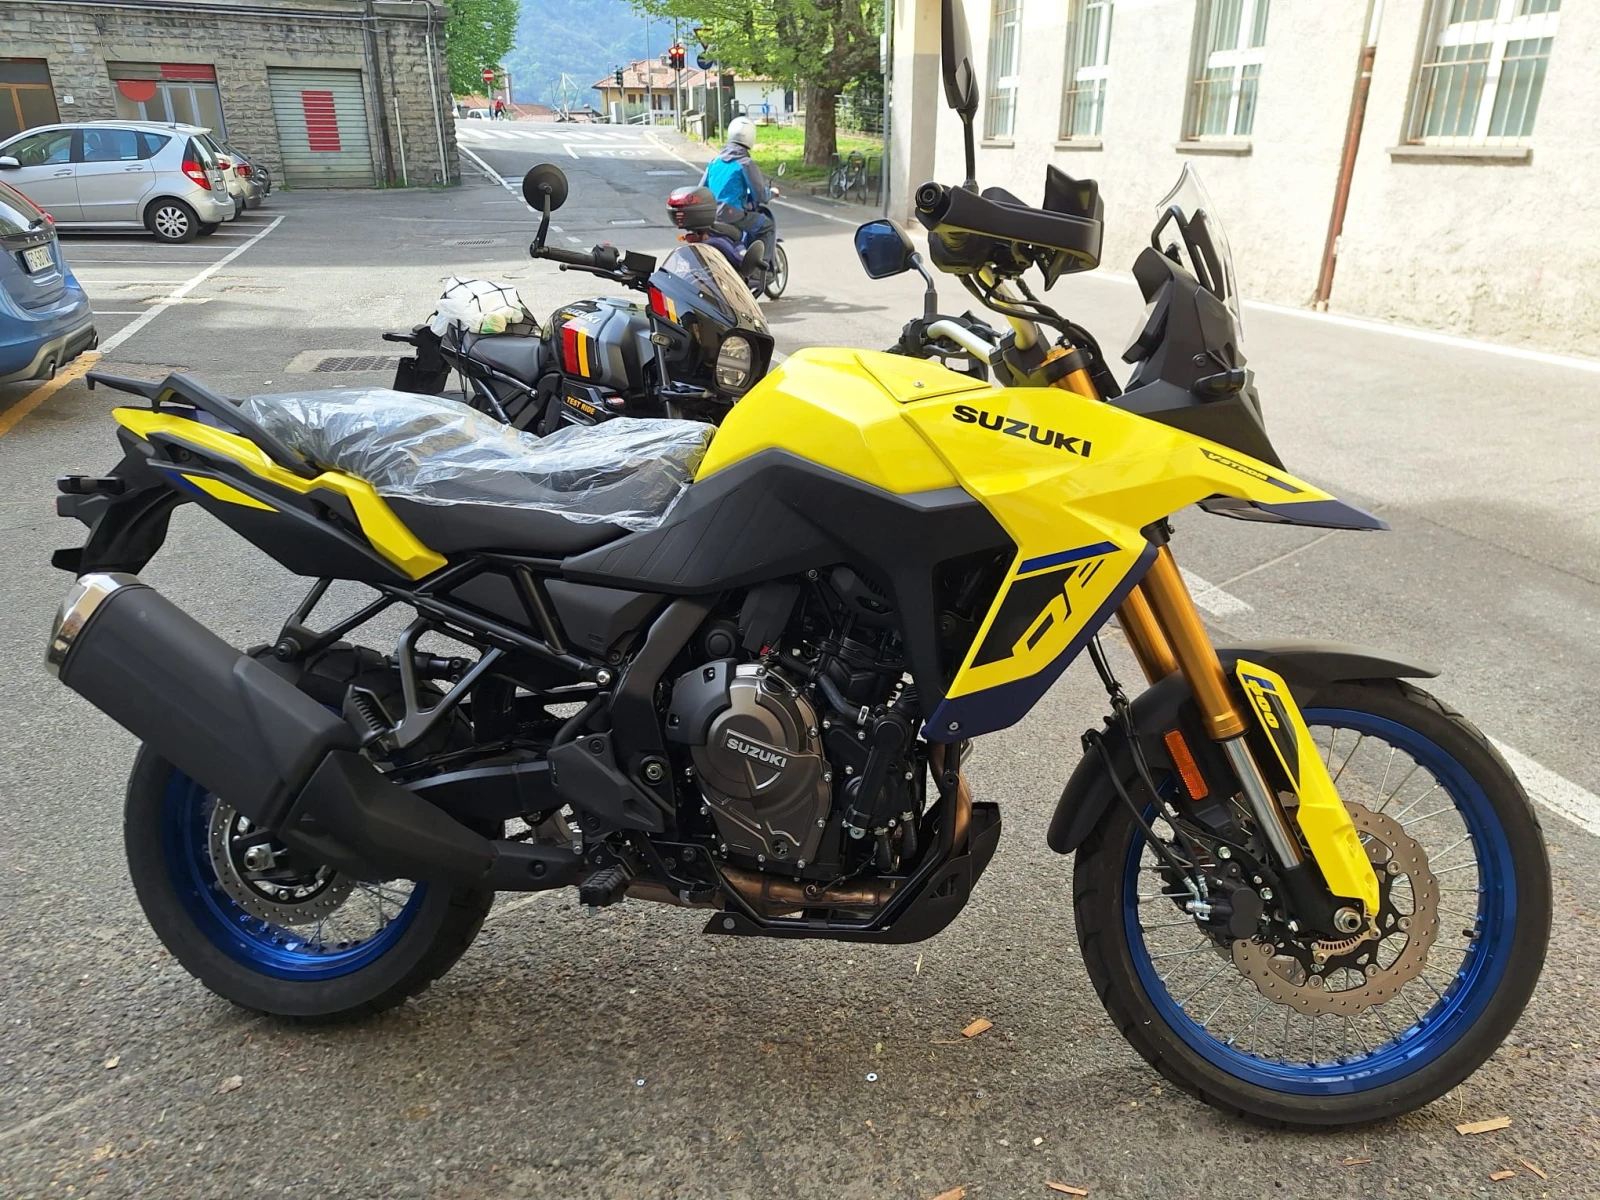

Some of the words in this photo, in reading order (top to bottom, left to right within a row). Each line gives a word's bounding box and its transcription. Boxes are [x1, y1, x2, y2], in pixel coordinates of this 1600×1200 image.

[562, 307, 601, 324] SUZUKI
[566, 396, 582, 408] TEST
[581, 403, 596, 415] RIDE
[952, 404, 1092, 458] SUZUKI
[1246, 678, 1280, 729] 800
[726, 738, 787, 768] SUZUKI
